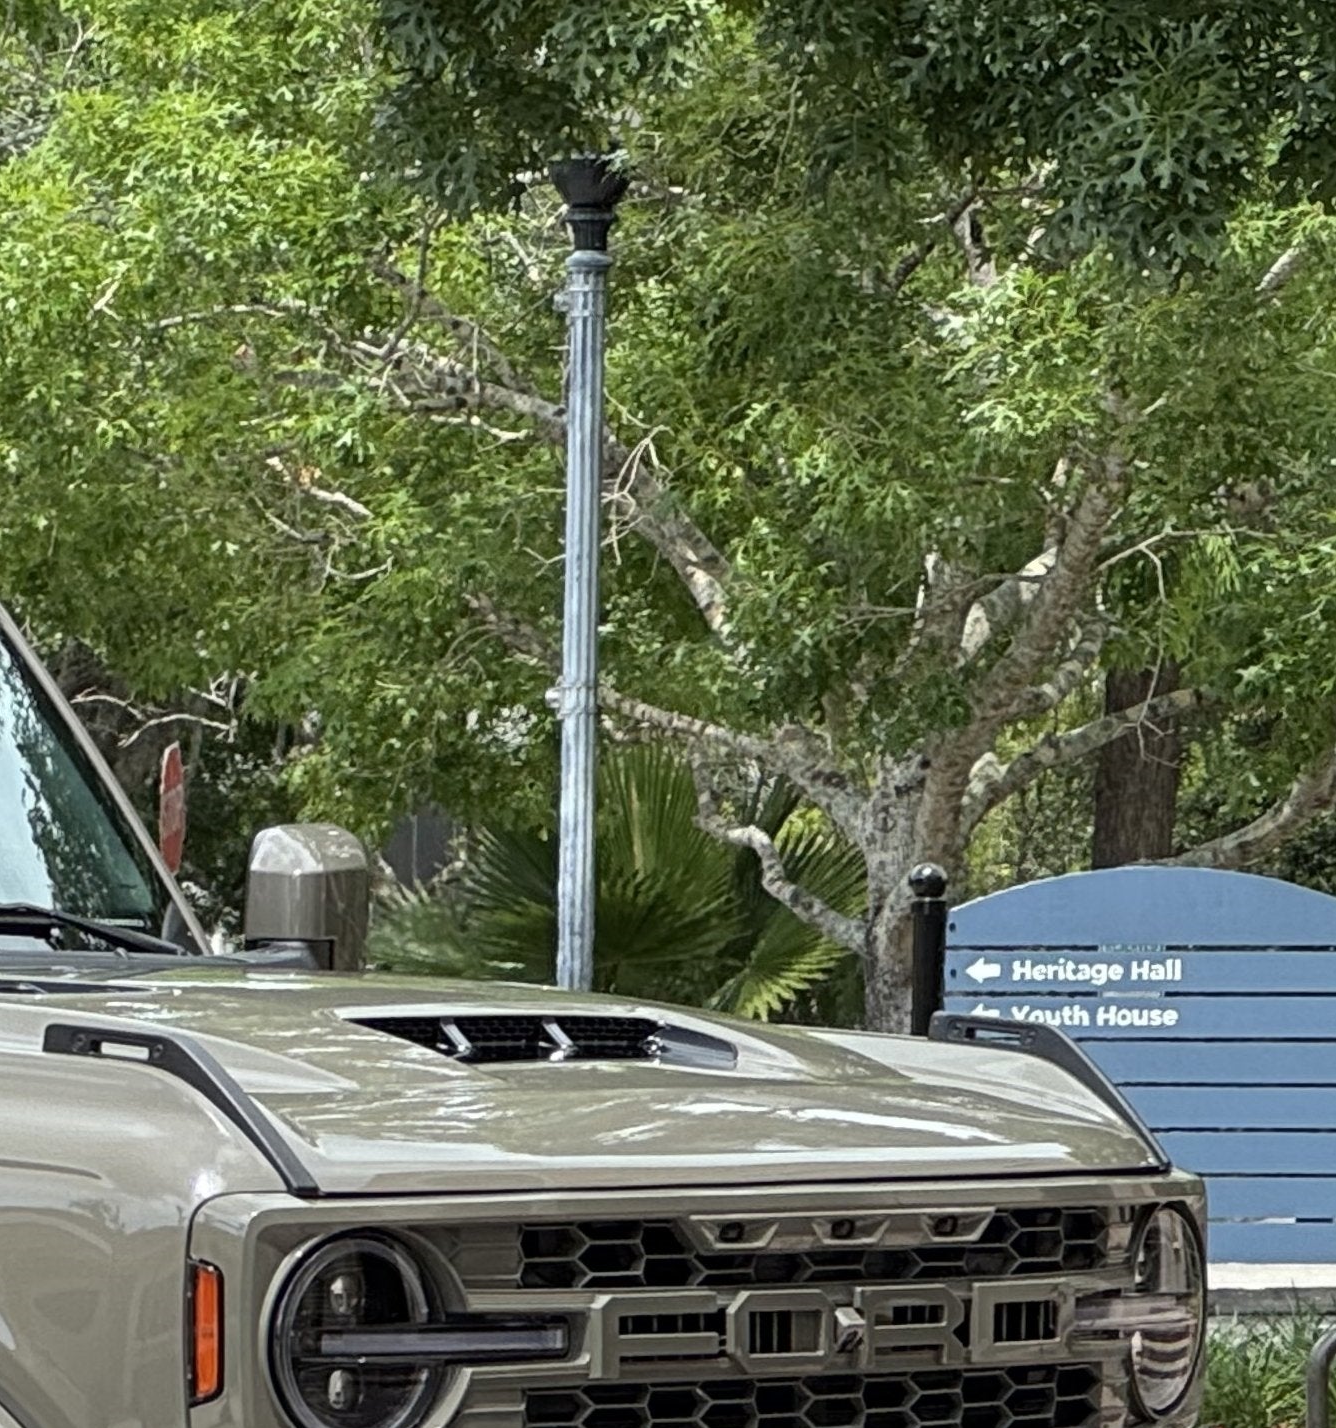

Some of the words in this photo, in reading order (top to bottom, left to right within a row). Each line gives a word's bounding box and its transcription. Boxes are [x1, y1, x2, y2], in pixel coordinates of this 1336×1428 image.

[1012, 958, 1124, 985] Heritage
[1131, 958, 1182, 981] Hall
[1011, 1005, 1090, 1026] Youth
[1096, 1006, 1179, 1026] House
[589, 1282, 1077, 1379] FORD
